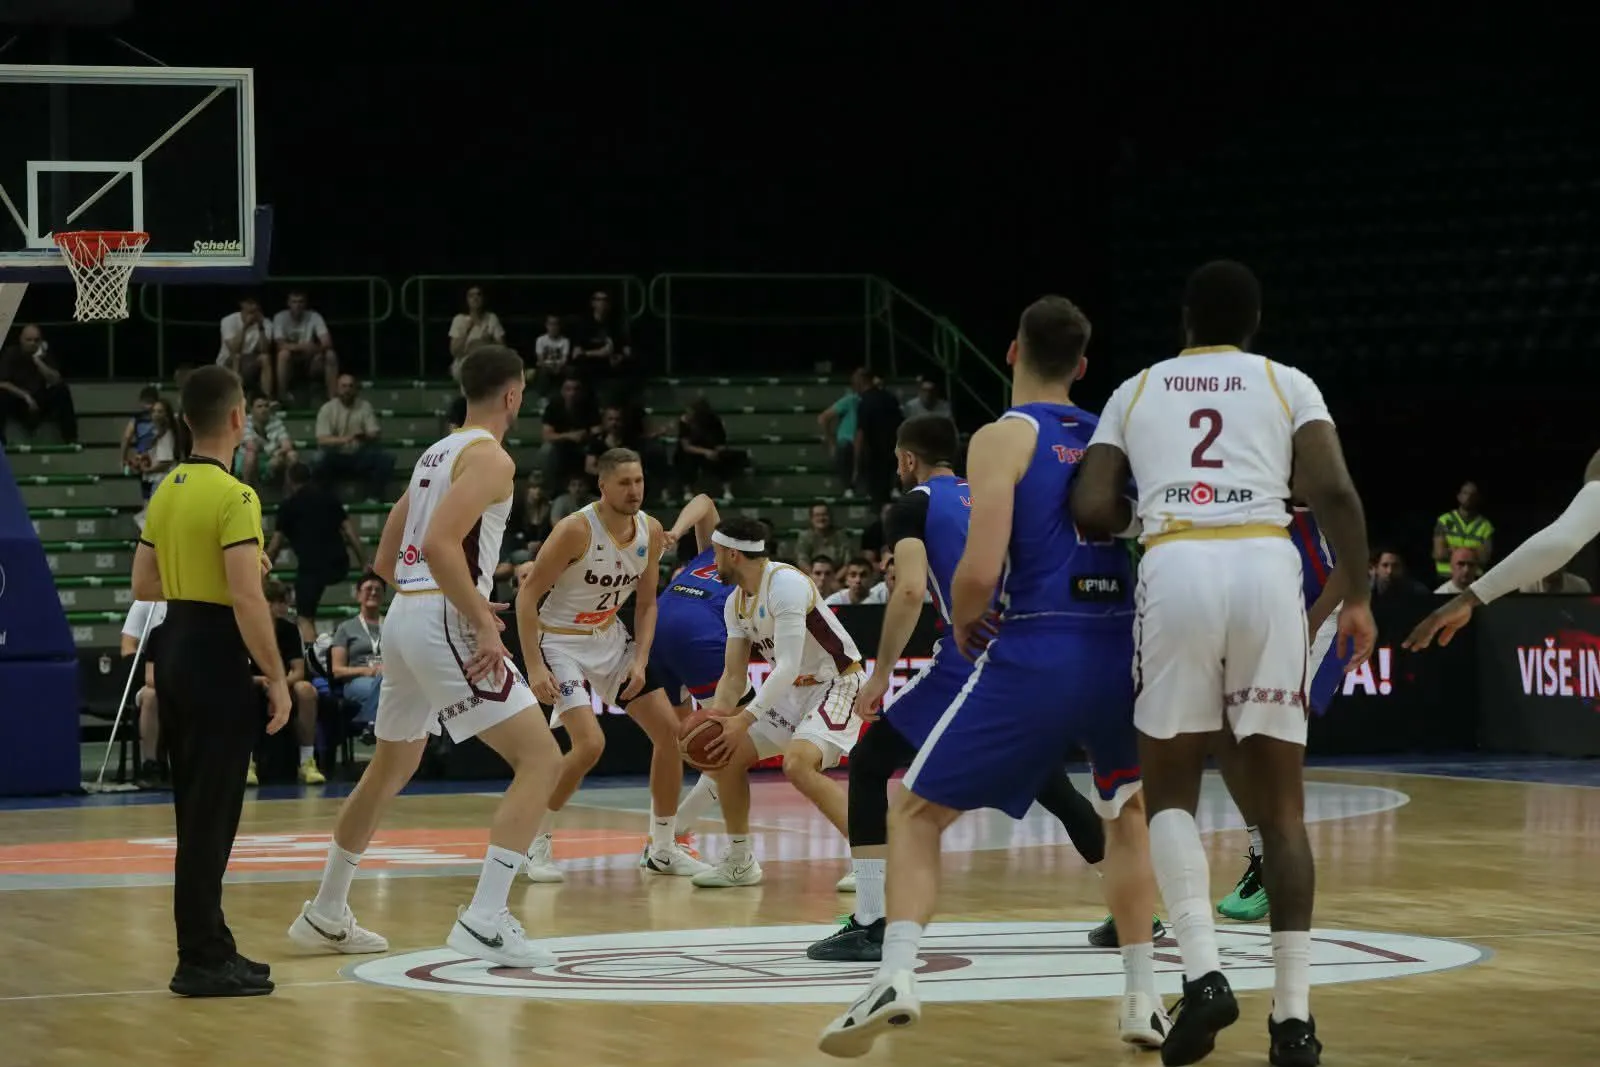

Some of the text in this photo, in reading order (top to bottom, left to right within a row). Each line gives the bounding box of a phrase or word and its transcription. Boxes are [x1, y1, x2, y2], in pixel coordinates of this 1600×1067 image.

[1164, 376, 1247, 392] YOUNG JR.
[1189, 408, 1224, 468] 2
[1164, 481, 1254, 505] PROLAB
[596, 590, 621, 611] 21
[1517, 636, 1574, 697] VIŠE
